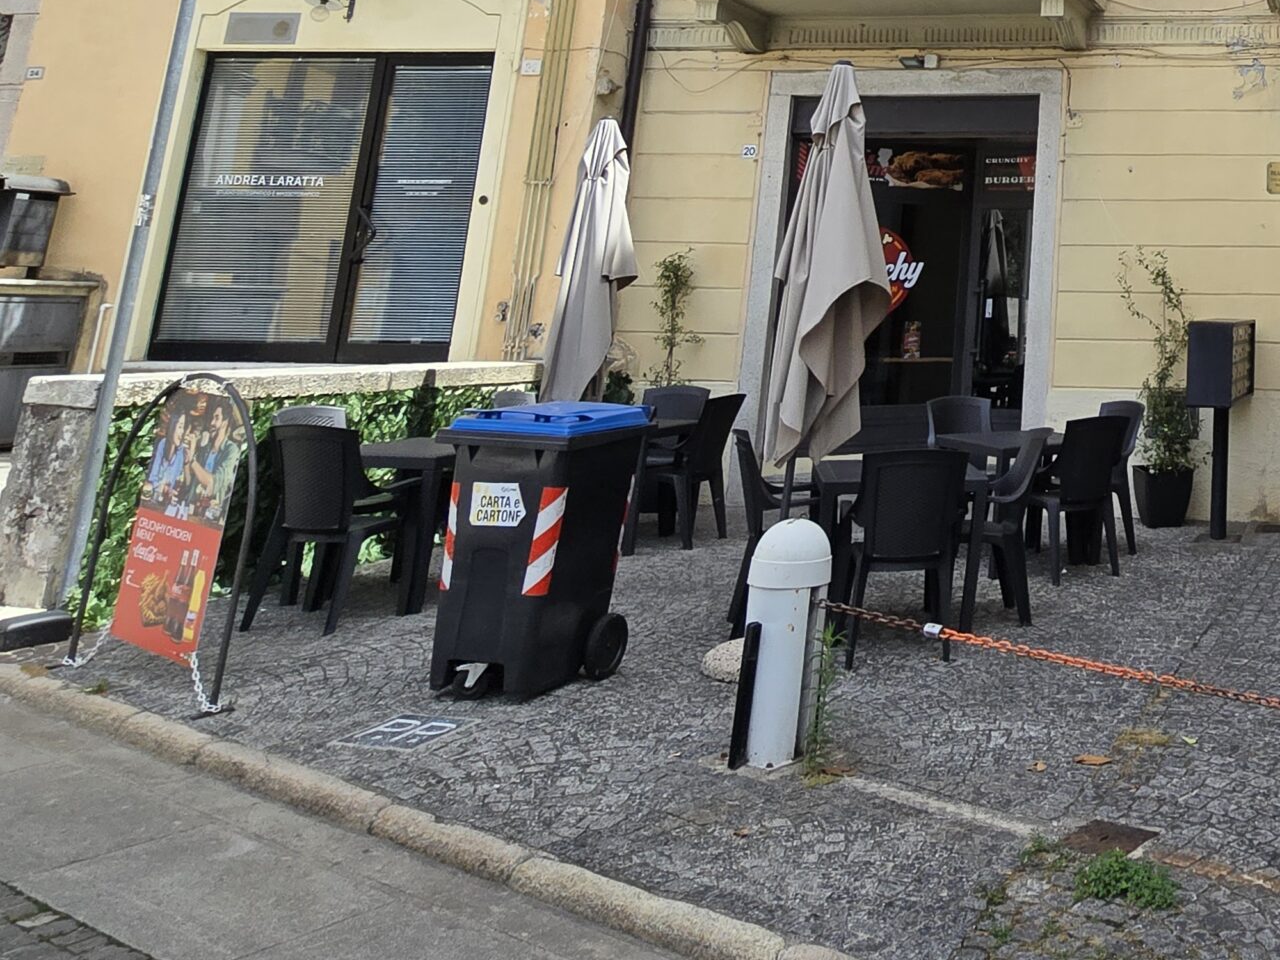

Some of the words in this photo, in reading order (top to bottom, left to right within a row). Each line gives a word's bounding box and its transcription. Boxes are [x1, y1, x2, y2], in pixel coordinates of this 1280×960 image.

[743, 146, 756, 156] 20
[215, 175, 266, 186] ANDREA
[269, 175, 324, 187] LARATTA
[985, 176, 1035, 184] BURGER
[480, 495, 511, 508] CARTA
[513, 498, 521, 509] e
